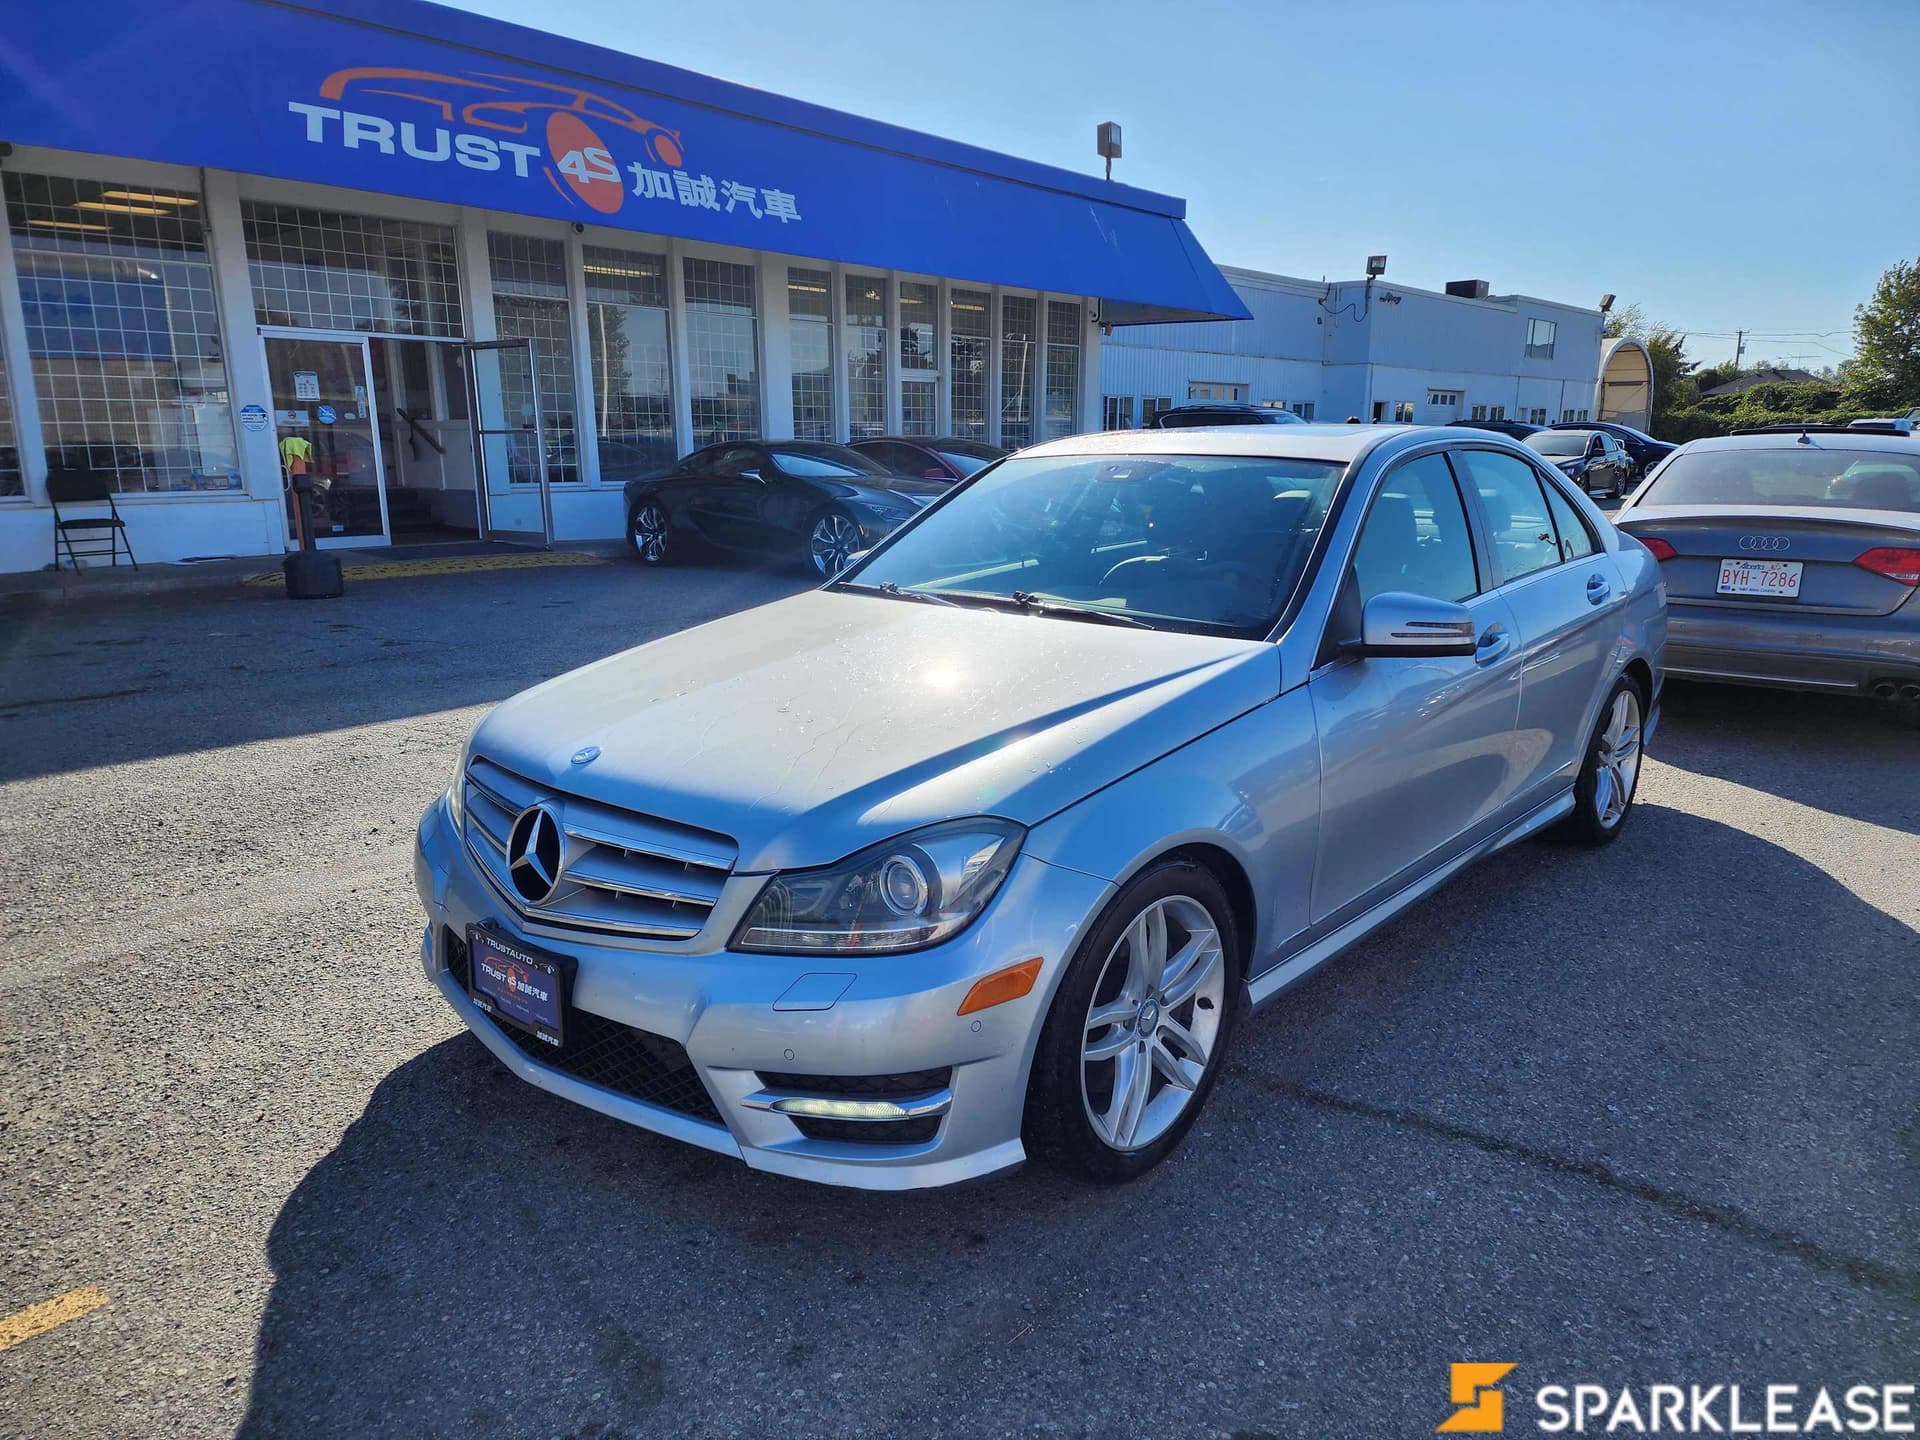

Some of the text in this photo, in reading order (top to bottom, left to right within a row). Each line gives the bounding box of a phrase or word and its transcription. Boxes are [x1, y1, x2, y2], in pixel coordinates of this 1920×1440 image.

[289, 101, 802, 224] TRUST 4S 加誠汽車
[1739, 562, 1765, 570] Alberta
[1721, 569, 1797, 587] BYH-7286
[486, 938, 533, 963] TRUSTAUTO
[481, 963, 506, 983] TRUST
